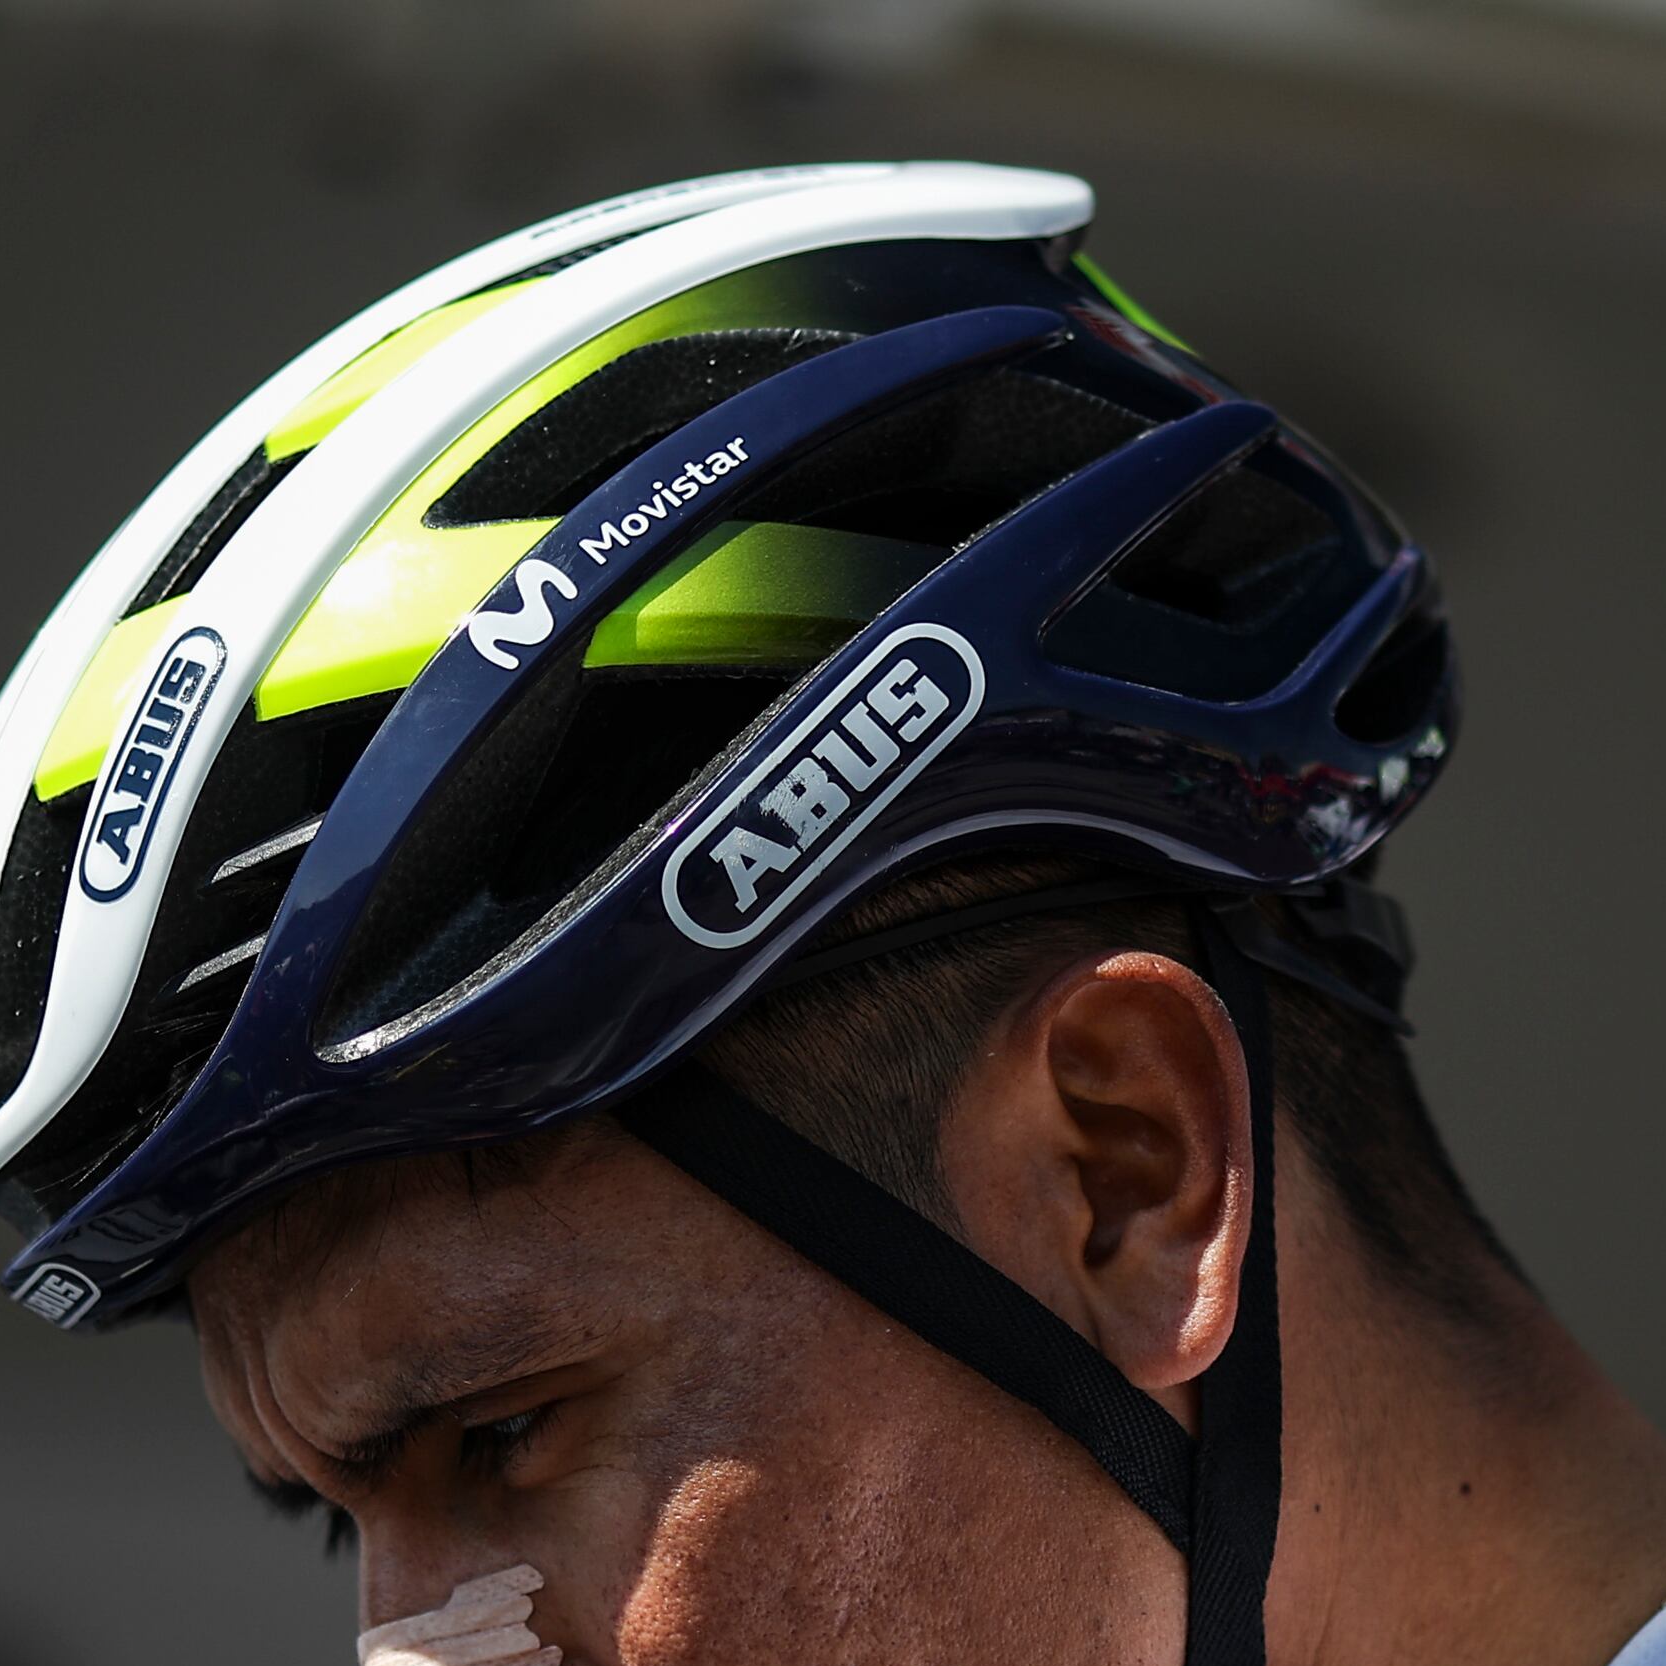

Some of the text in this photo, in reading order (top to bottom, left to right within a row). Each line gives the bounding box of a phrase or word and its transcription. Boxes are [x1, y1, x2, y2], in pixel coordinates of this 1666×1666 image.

[578, 436, 750, 566] Movistar
[95, 656, 207, 866] ABUS
[708, 658, 950, 914] ABUS
[22, 1273, 85, 1323] BUS
